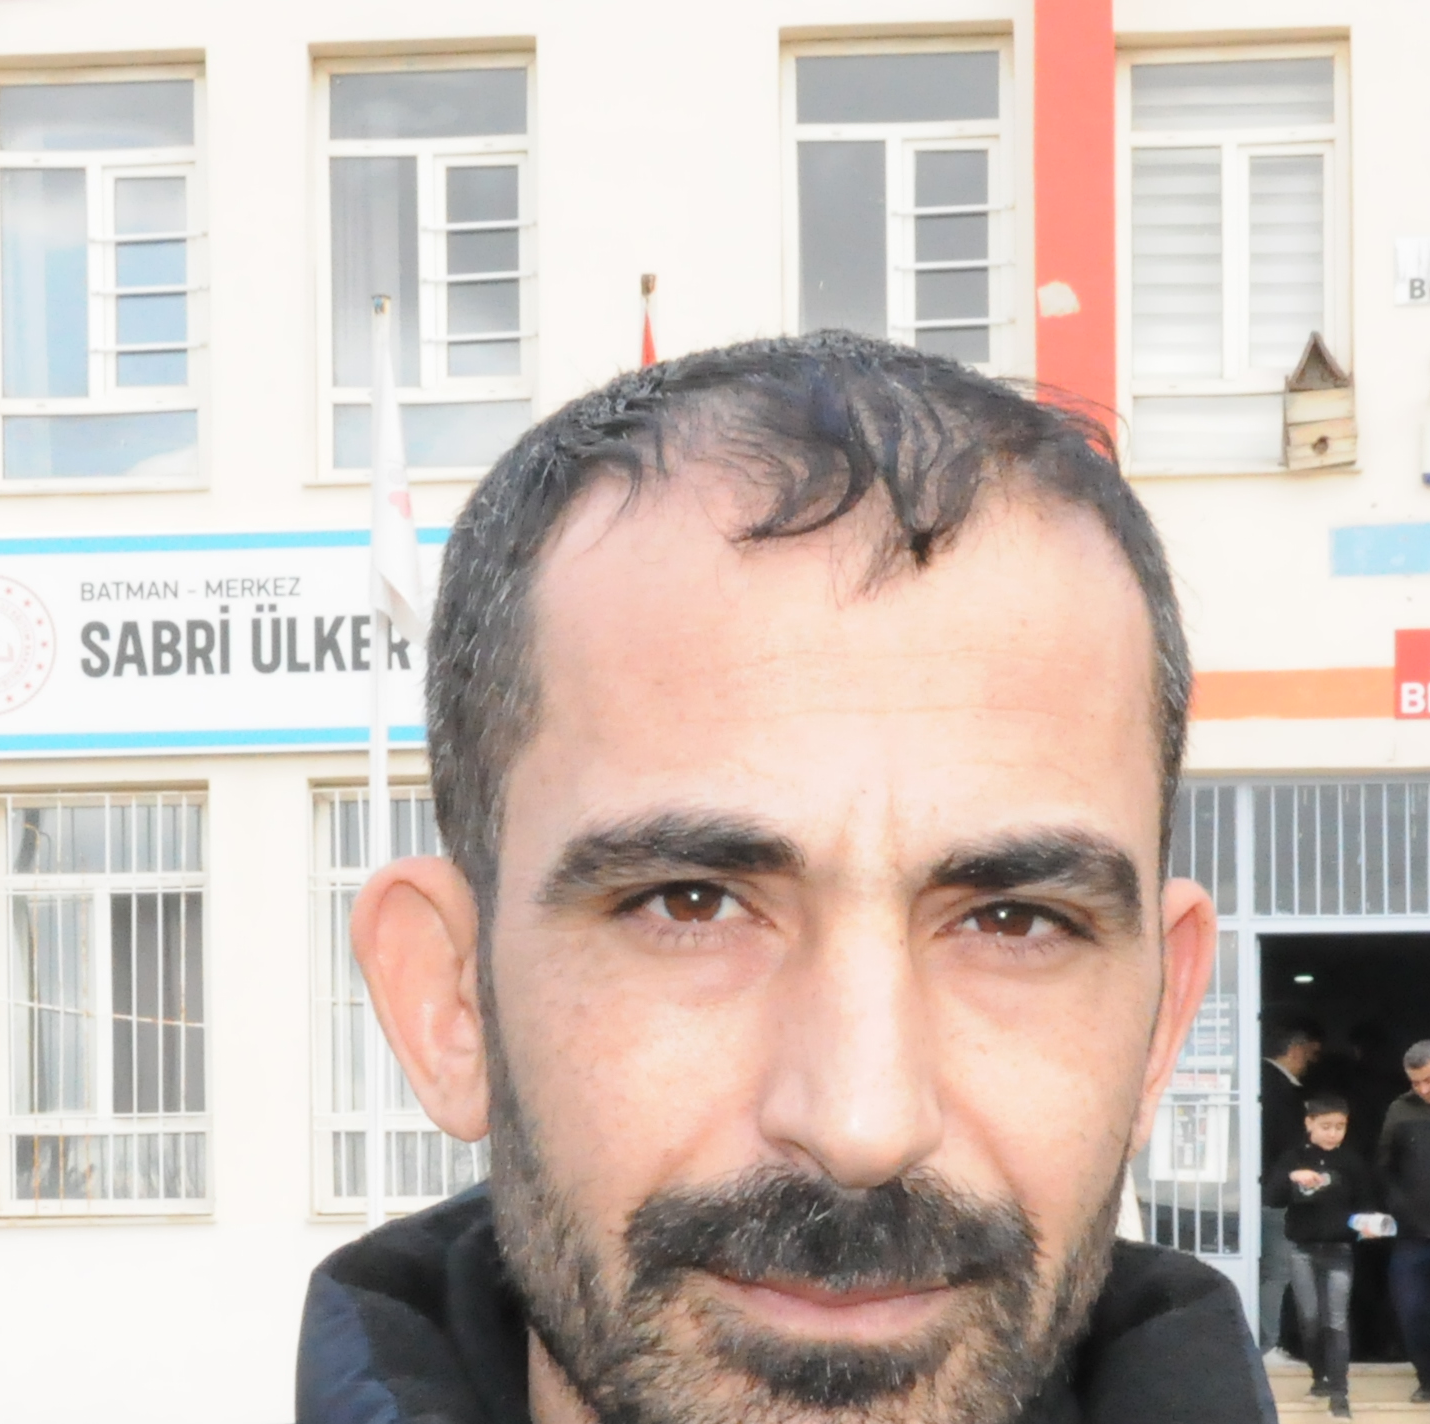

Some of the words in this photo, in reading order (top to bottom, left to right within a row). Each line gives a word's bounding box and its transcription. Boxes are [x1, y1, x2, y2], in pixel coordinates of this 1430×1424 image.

[80, 580, 180, 602] BATMAN
[204, 577, 302, 599] MERKEZ
[80, 604, 231, 678] SABRİ
